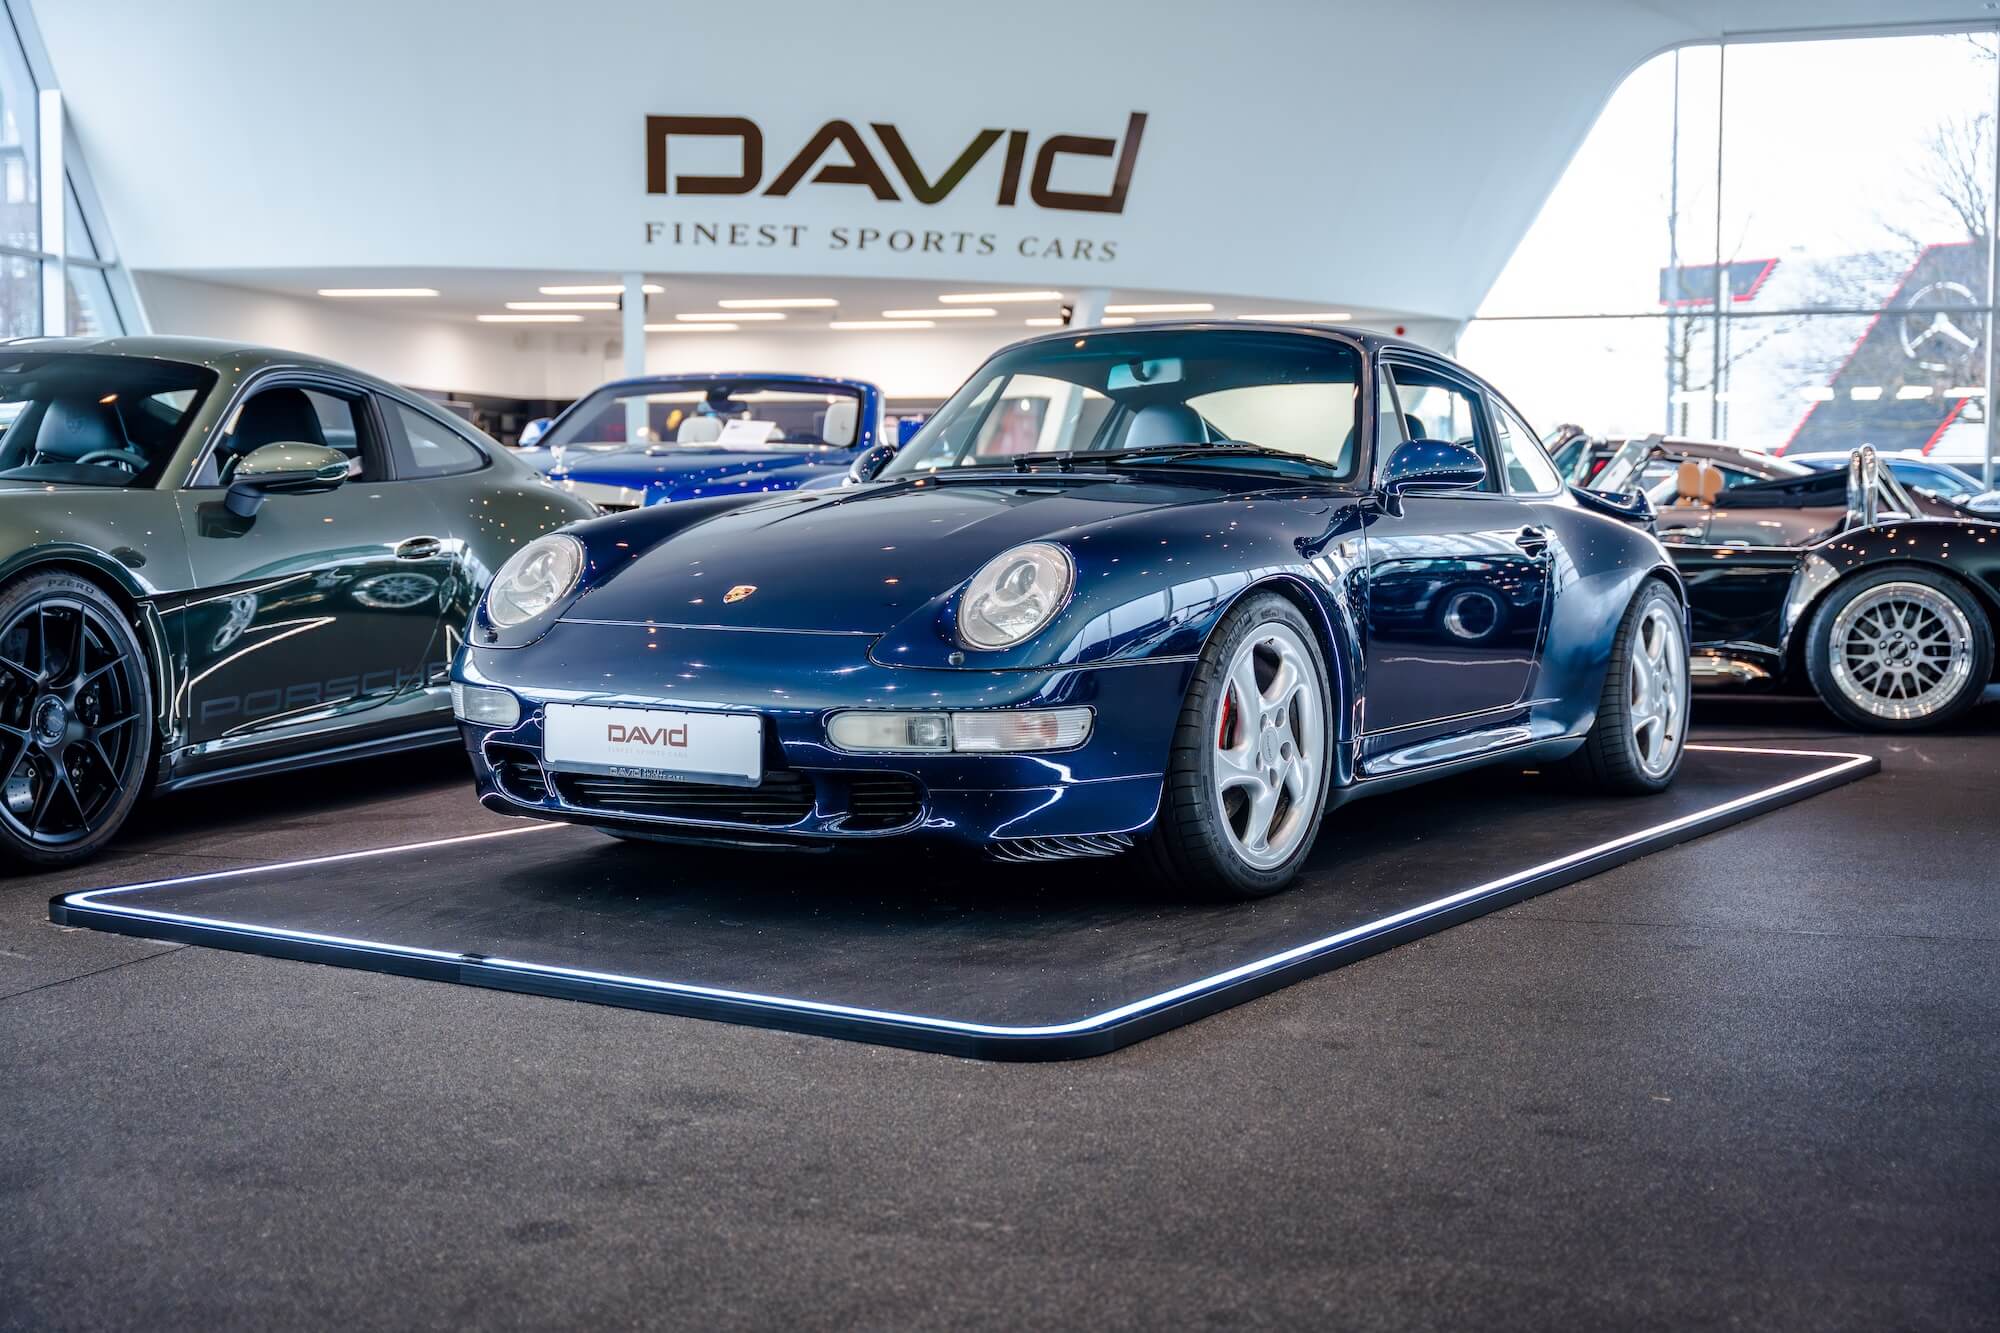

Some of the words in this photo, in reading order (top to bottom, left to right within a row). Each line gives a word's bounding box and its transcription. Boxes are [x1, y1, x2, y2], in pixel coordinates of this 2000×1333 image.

[645, 222, 807, 248] FINEST
[829, 227, 996, 256] SPORTS
[1017, 236, 1118, 263] CARS
